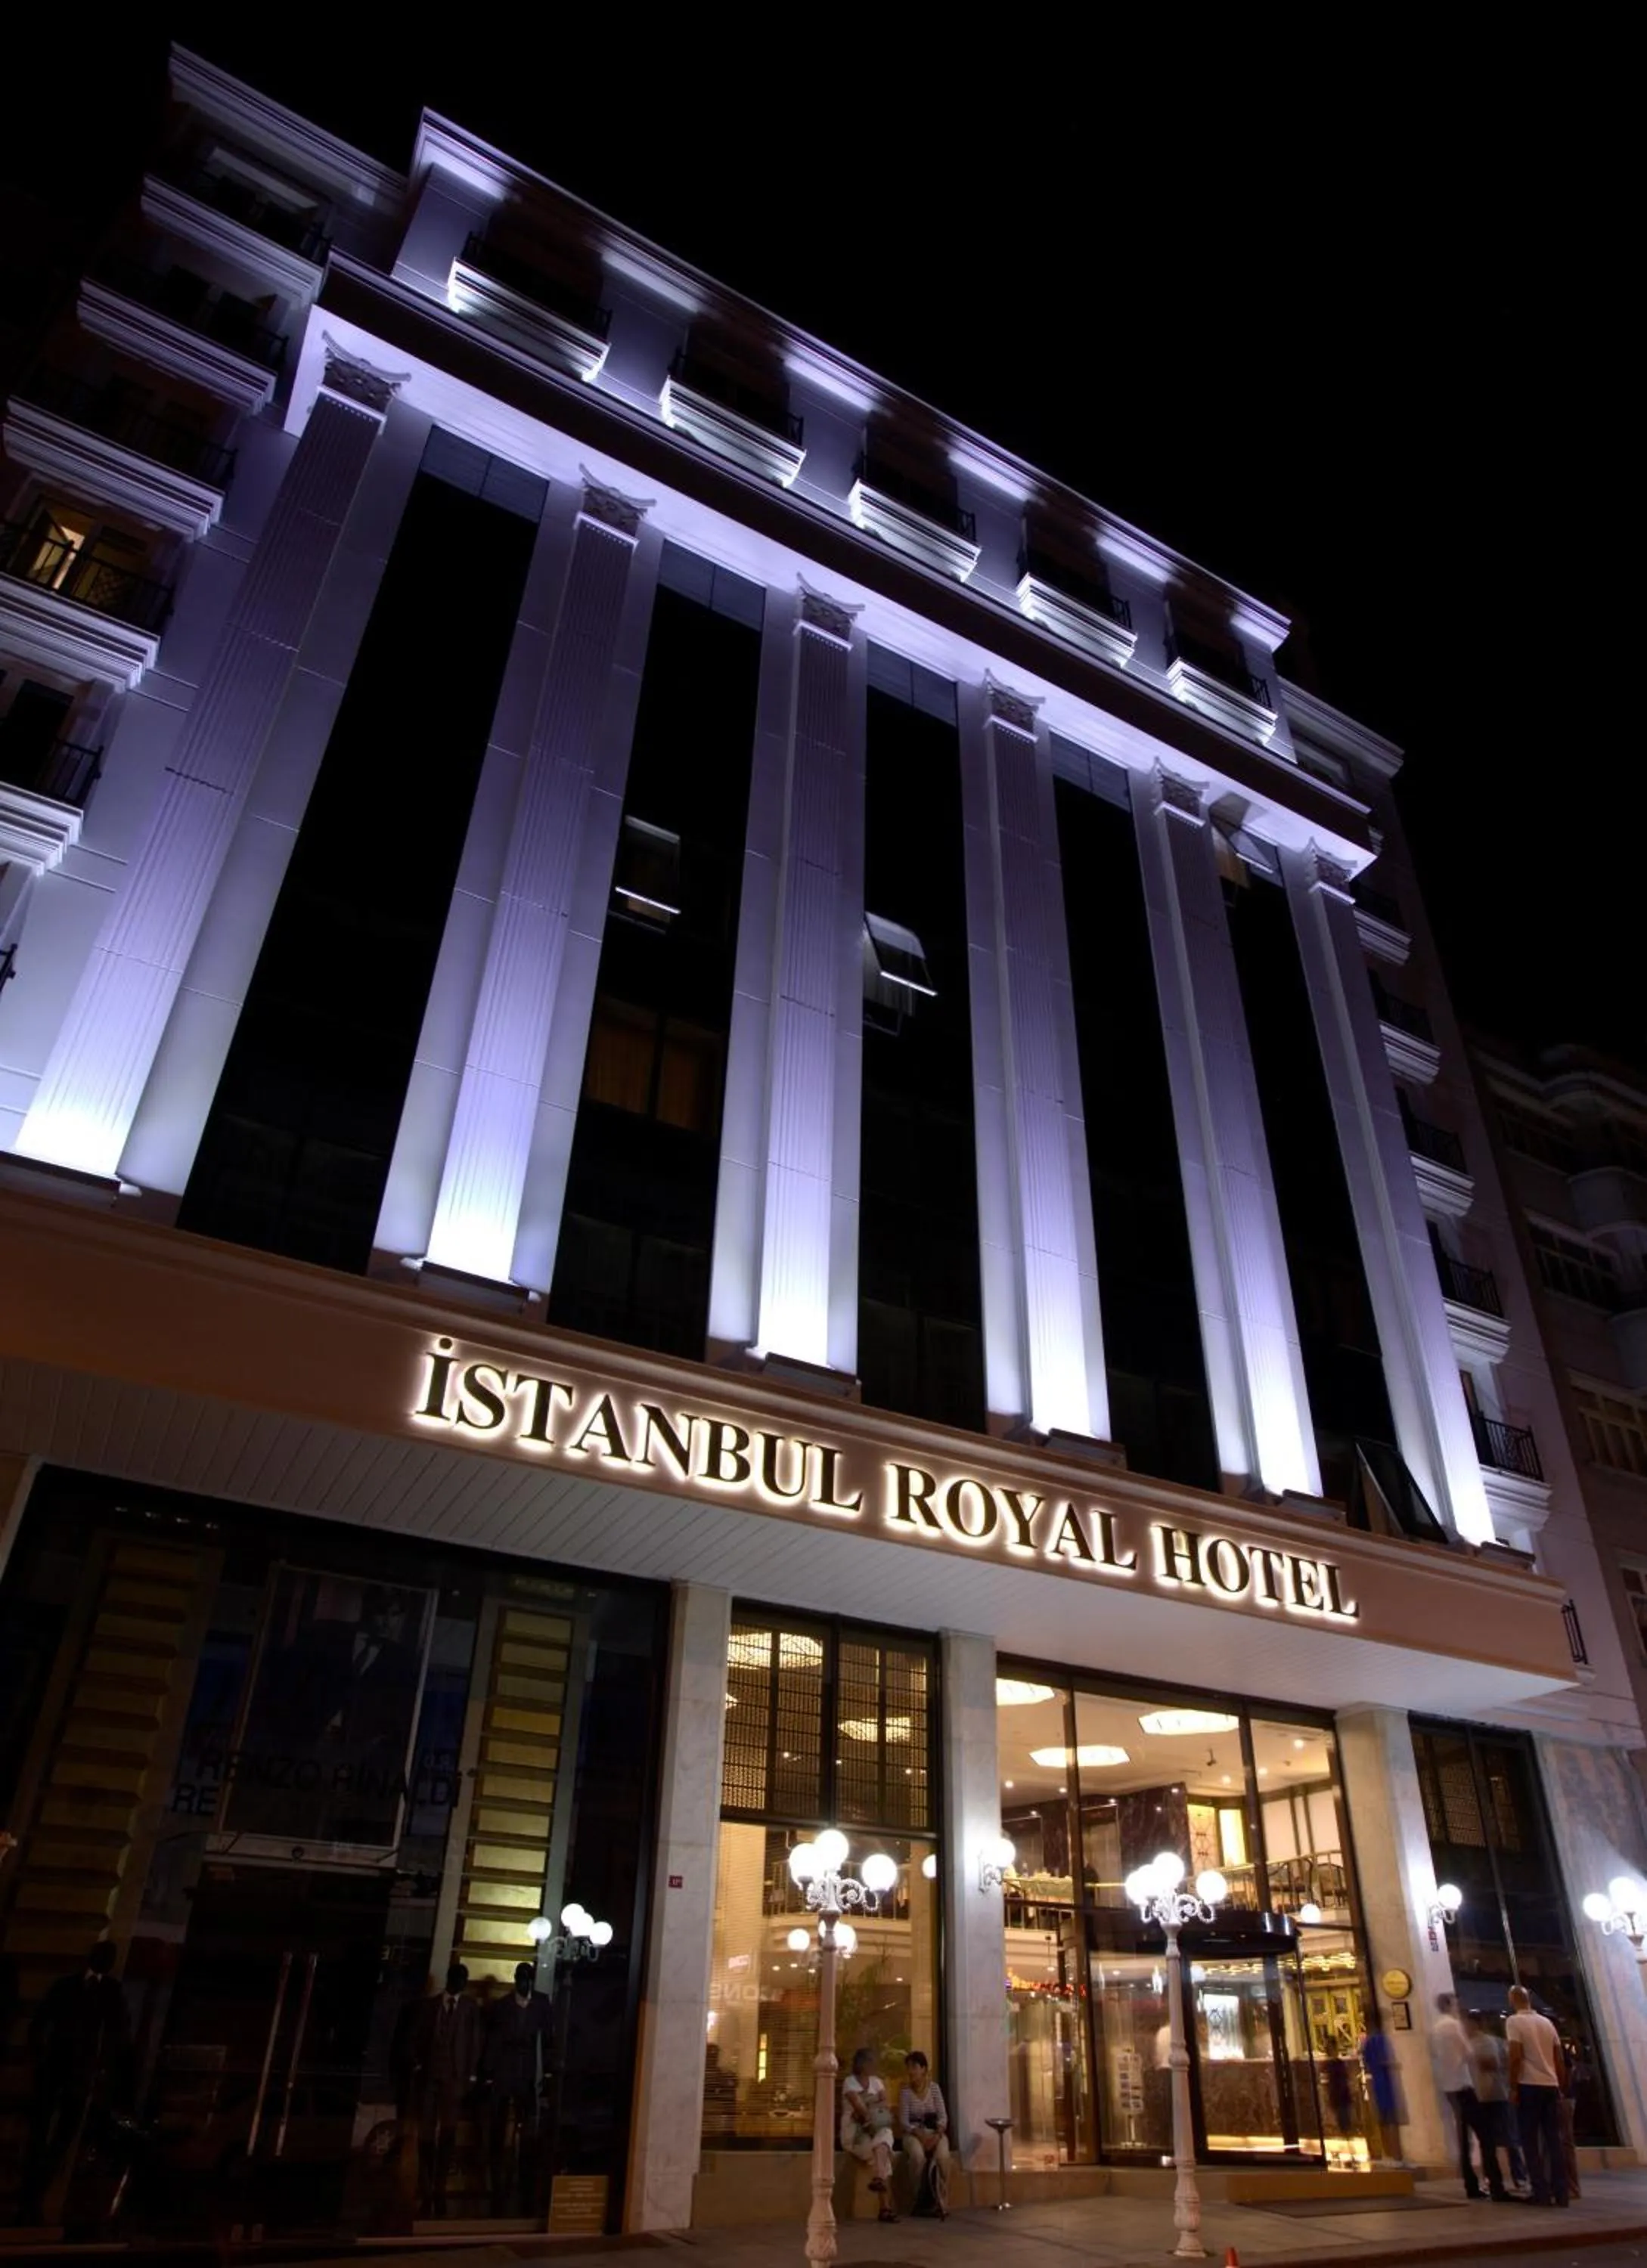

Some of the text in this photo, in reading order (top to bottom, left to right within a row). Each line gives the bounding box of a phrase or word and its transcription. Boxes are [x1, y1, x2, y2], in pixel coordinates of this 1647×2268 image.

[414, 1337, 1360, 1619] İSTANBUL ROYAL HOTEL
